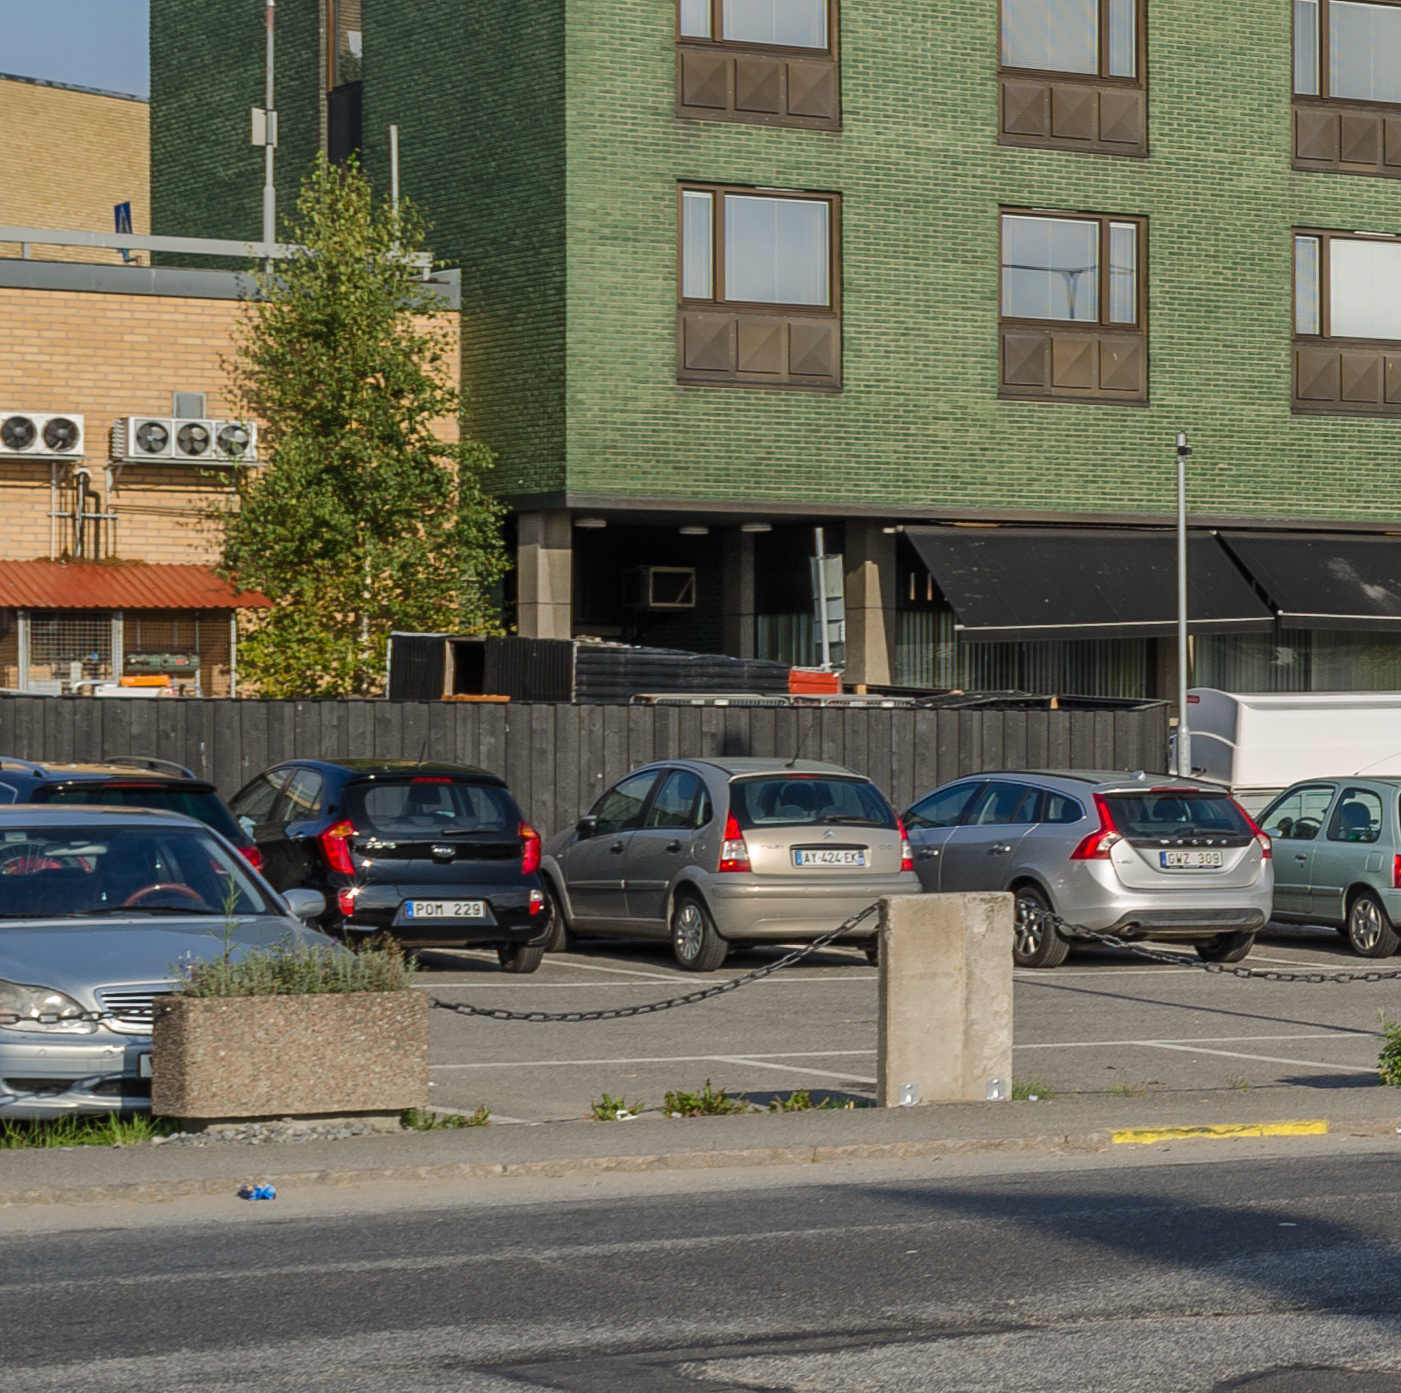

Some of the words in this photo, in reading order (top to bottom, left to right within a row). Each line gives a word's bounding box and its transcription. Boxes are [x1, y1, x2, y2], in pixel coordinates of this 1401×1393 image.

[1168, 853, 1190, 864] GWZ
[1197, 853, 1219, 864] 309
[416, 903, 444, 916] POM
[454, 903, 480, 916] 229
